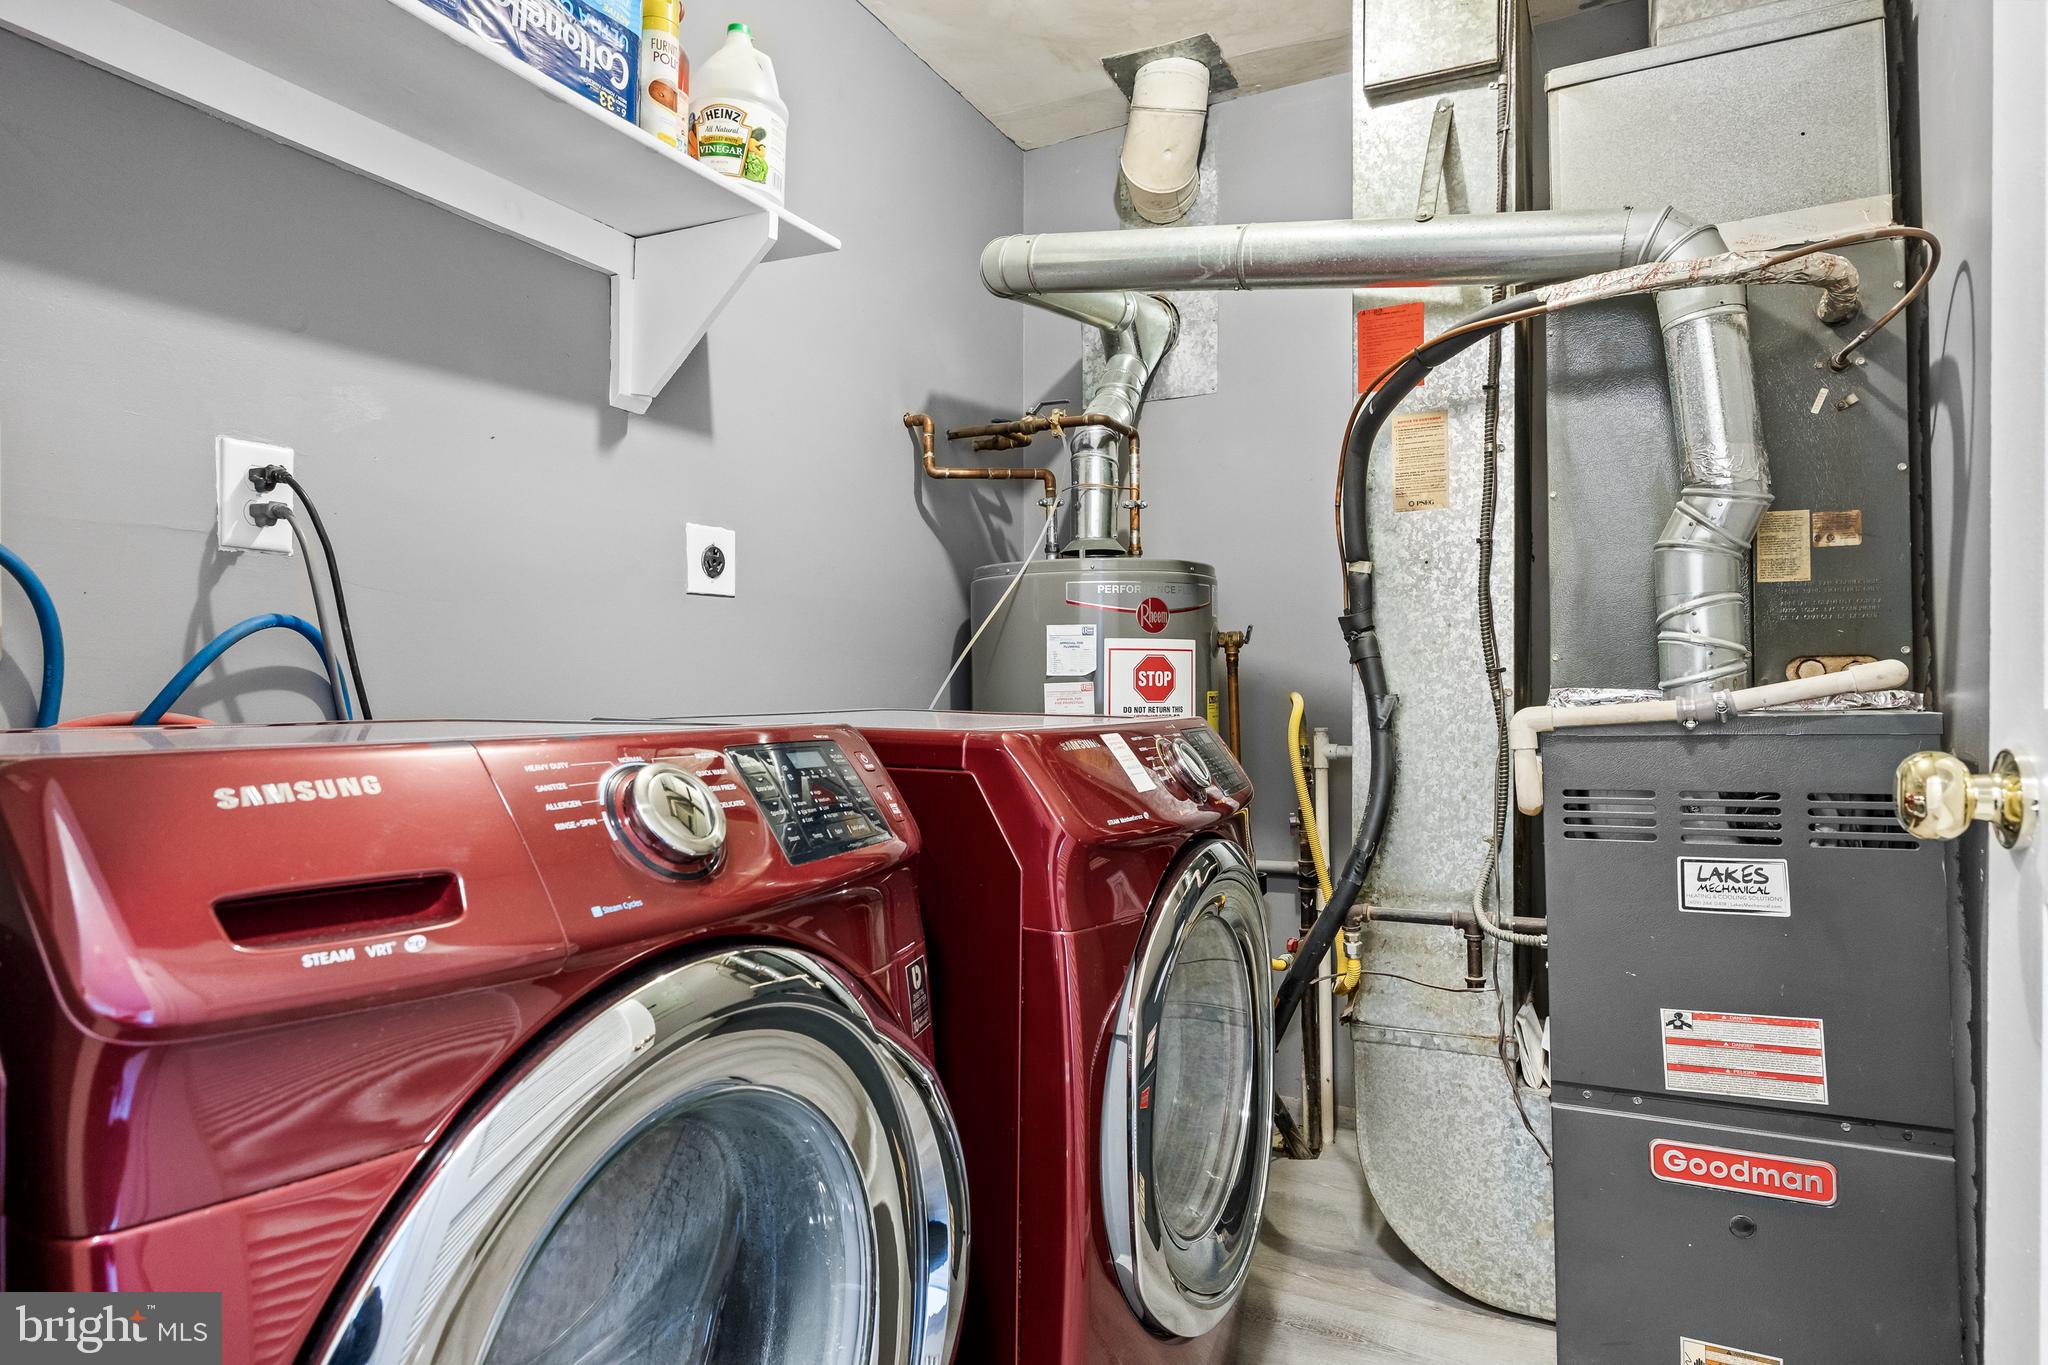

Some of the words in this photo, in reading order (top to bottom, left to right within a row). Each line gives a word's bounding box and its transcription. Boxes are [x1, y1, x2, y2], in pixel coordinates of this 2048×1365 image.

[599, 90, 615, 111] 33
[705, 109, 741, 123] HEINZ
[715, 125, 740, 134] Natural
[700, 145, 743, 155] VINEGAR
[1140, 598, 1168, 628] Rheem
[1138, 671, 1172, 687] STOP
[1172, 705, 1184, 713] THIS
[1060, 739, 1100, 751] SAMSUNG
[524, 764, 549, 772] HEAVY
[550, 762, 569, 770] DUTY
[213, 775, 382, 810] SAMSUNG
[535, 783, 568, 792] SANITIZE
[545, 800, 582, 811] ALLERGEN
[1697, 865, 1769, 884] LAKES
[1697, 883, 1770, 895] MECHANICAL
[602, 904, 623, 914] Steam
[623, 899, 644, 910] Cycles
[301, 948, 356, 968] STEAM
[1662, 1149, 1823, 1194] Goodman
